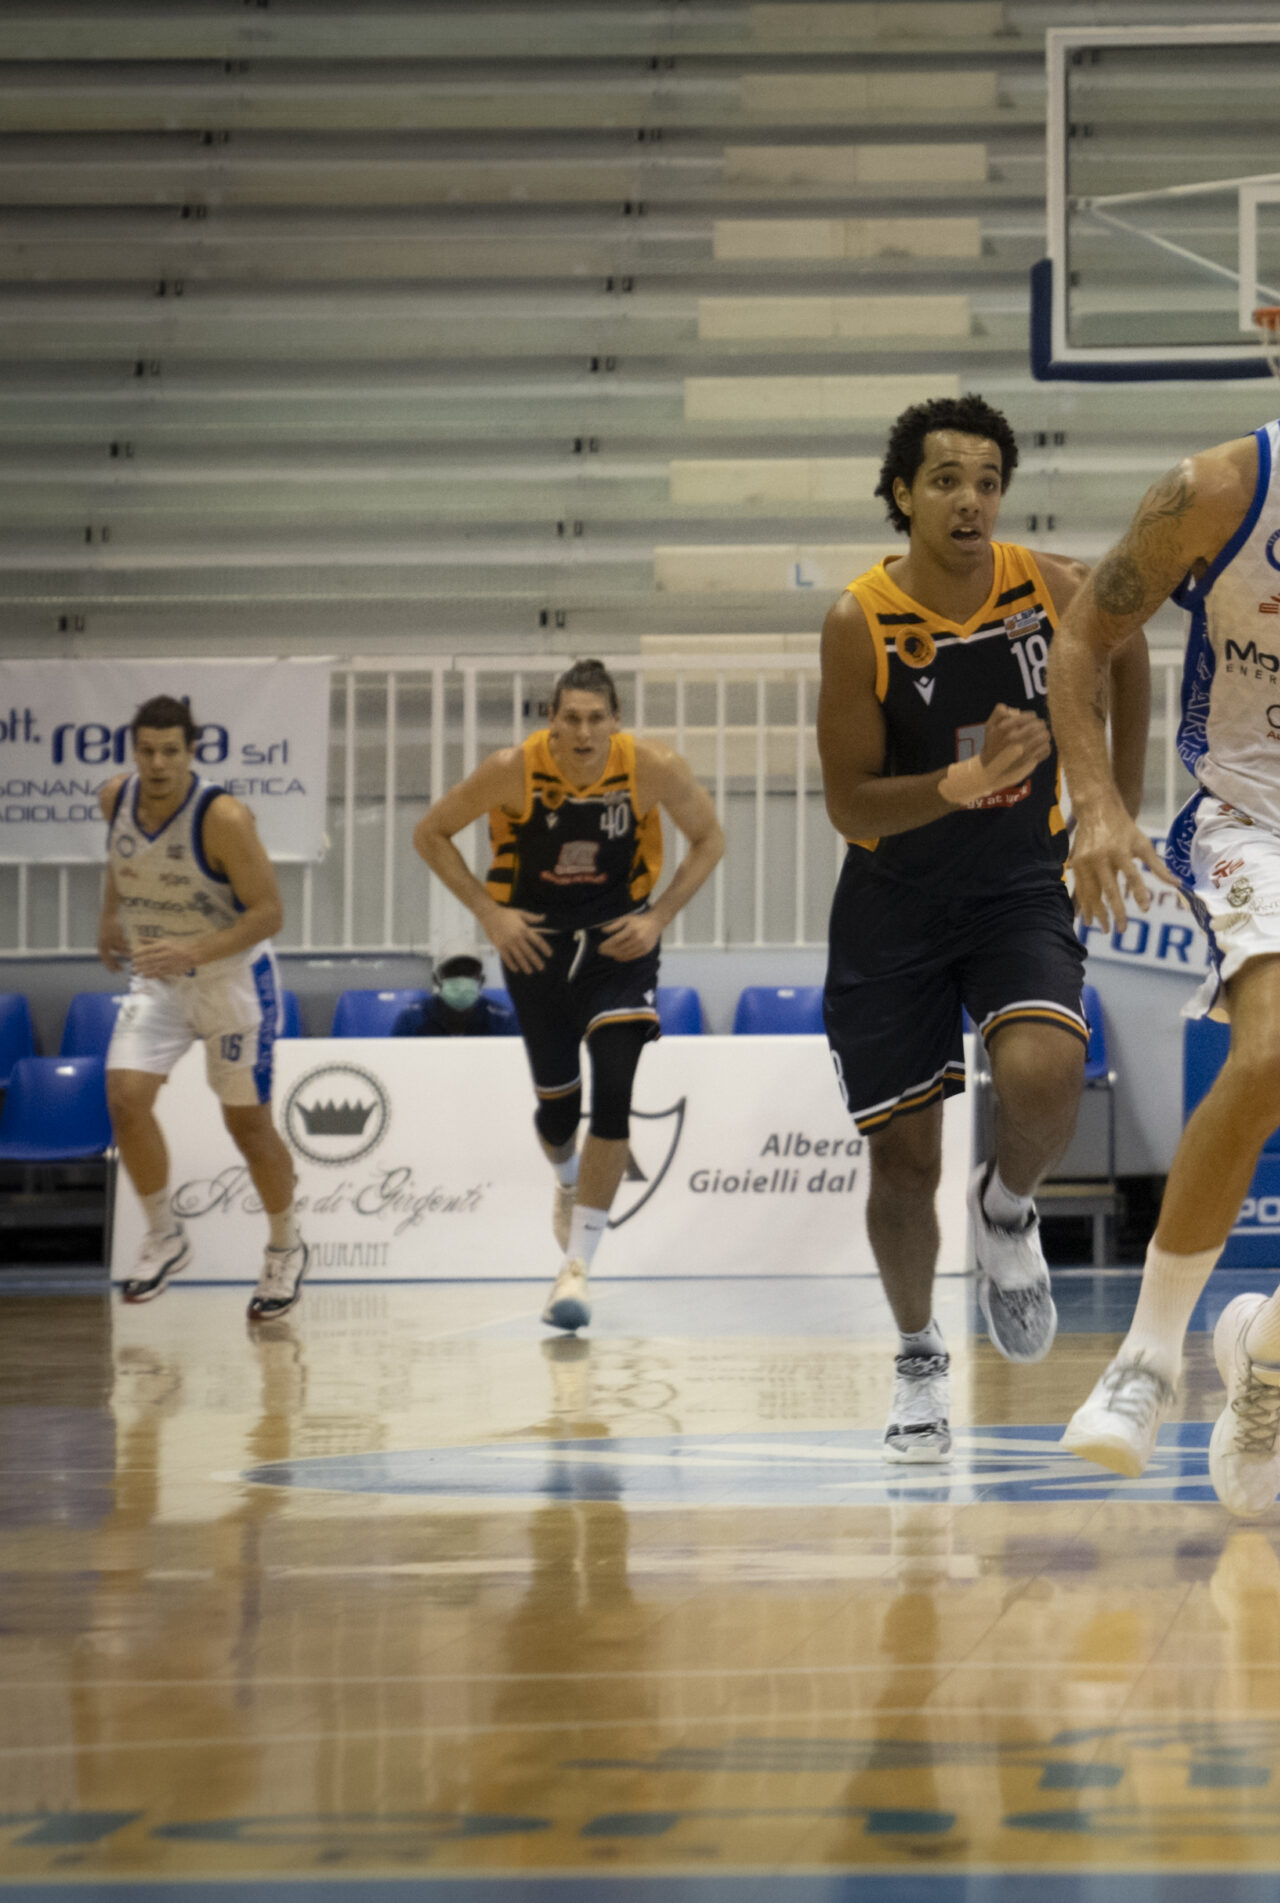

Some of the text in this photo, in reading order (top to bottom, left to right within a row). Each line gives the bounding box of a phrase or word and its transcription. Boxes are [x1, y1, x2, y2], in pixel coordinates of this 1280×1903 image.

[1010, 634, 1048, 700] 18
[241, 740, 288, 764] srl
[600, 803, 631, 839] 40
[760, 1132, 864, 1158] Albera
[689, 1169, 857, 1195] Gioielli dal
